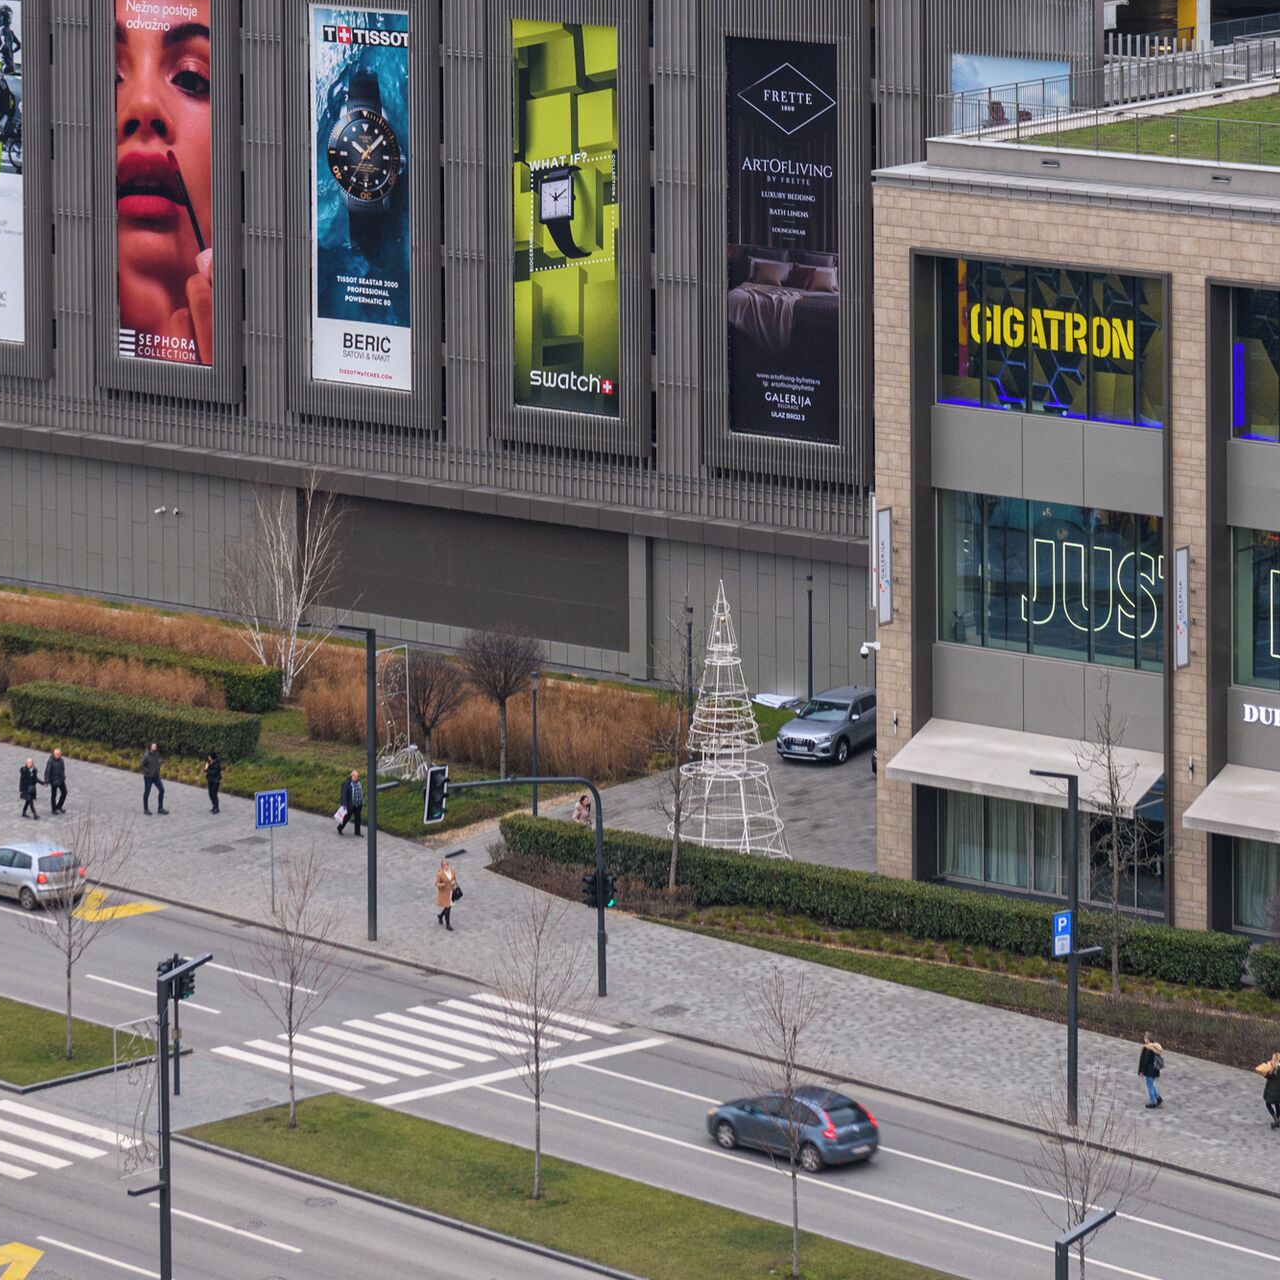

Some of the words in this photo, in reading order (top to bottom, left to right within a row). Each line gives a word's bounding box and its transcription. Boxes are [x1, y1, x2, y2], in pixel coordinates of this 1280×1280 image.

[125, 0, 160, 14] Nežno
[162, 3, 198, 21] postaje
[126, 14, 171, 32] odvažno
[353, 28, 409, 48] TISSOT
[763, 89, 813, 105] FRETTE
[529, 155, 567, 172] WHAT
[570, 151, 588, 166] IF?
[766, 175, 777, 183] BY
[780, 176, 811, 186] FRETTE
[761, 190, 787, 200] LUXURY
[787, 193, 816, 202] BEDDING
[769, 208, 786, 217] BATH
[787, 209, 809, 219] LINENS
[771, 226, 806, 236] LOUNGEWEAR
[336, 275, 357, 284] TISSOT
[358, 277, 383, 287] SEASTAR
[383, 280, 399, 289] 2000
[347, 285, 390, 297] PROFESSIONAL
[344, 295, 383, 306] POWERMATIC
[383, 298, 392, 307] 80
[970, 302, 1135, 361] GIGATRON
[138, 333, 196, 351] SEPHORA
[137, 346, 196, 361] COLLECTION
[342, 350, 365, 360] SATOVI
[365, 352, 371, 360] &
[371, 353, 391, 363] NAKIT
[339, 368, 393, 380] TISSOTWATCHES.COM
[529, 370, 601, 394] swatch
[764, 391, 812, 408] GALERIJA
[1021, 538, 1165, 640] JUS
[1058, 916, 1067, 932] P
